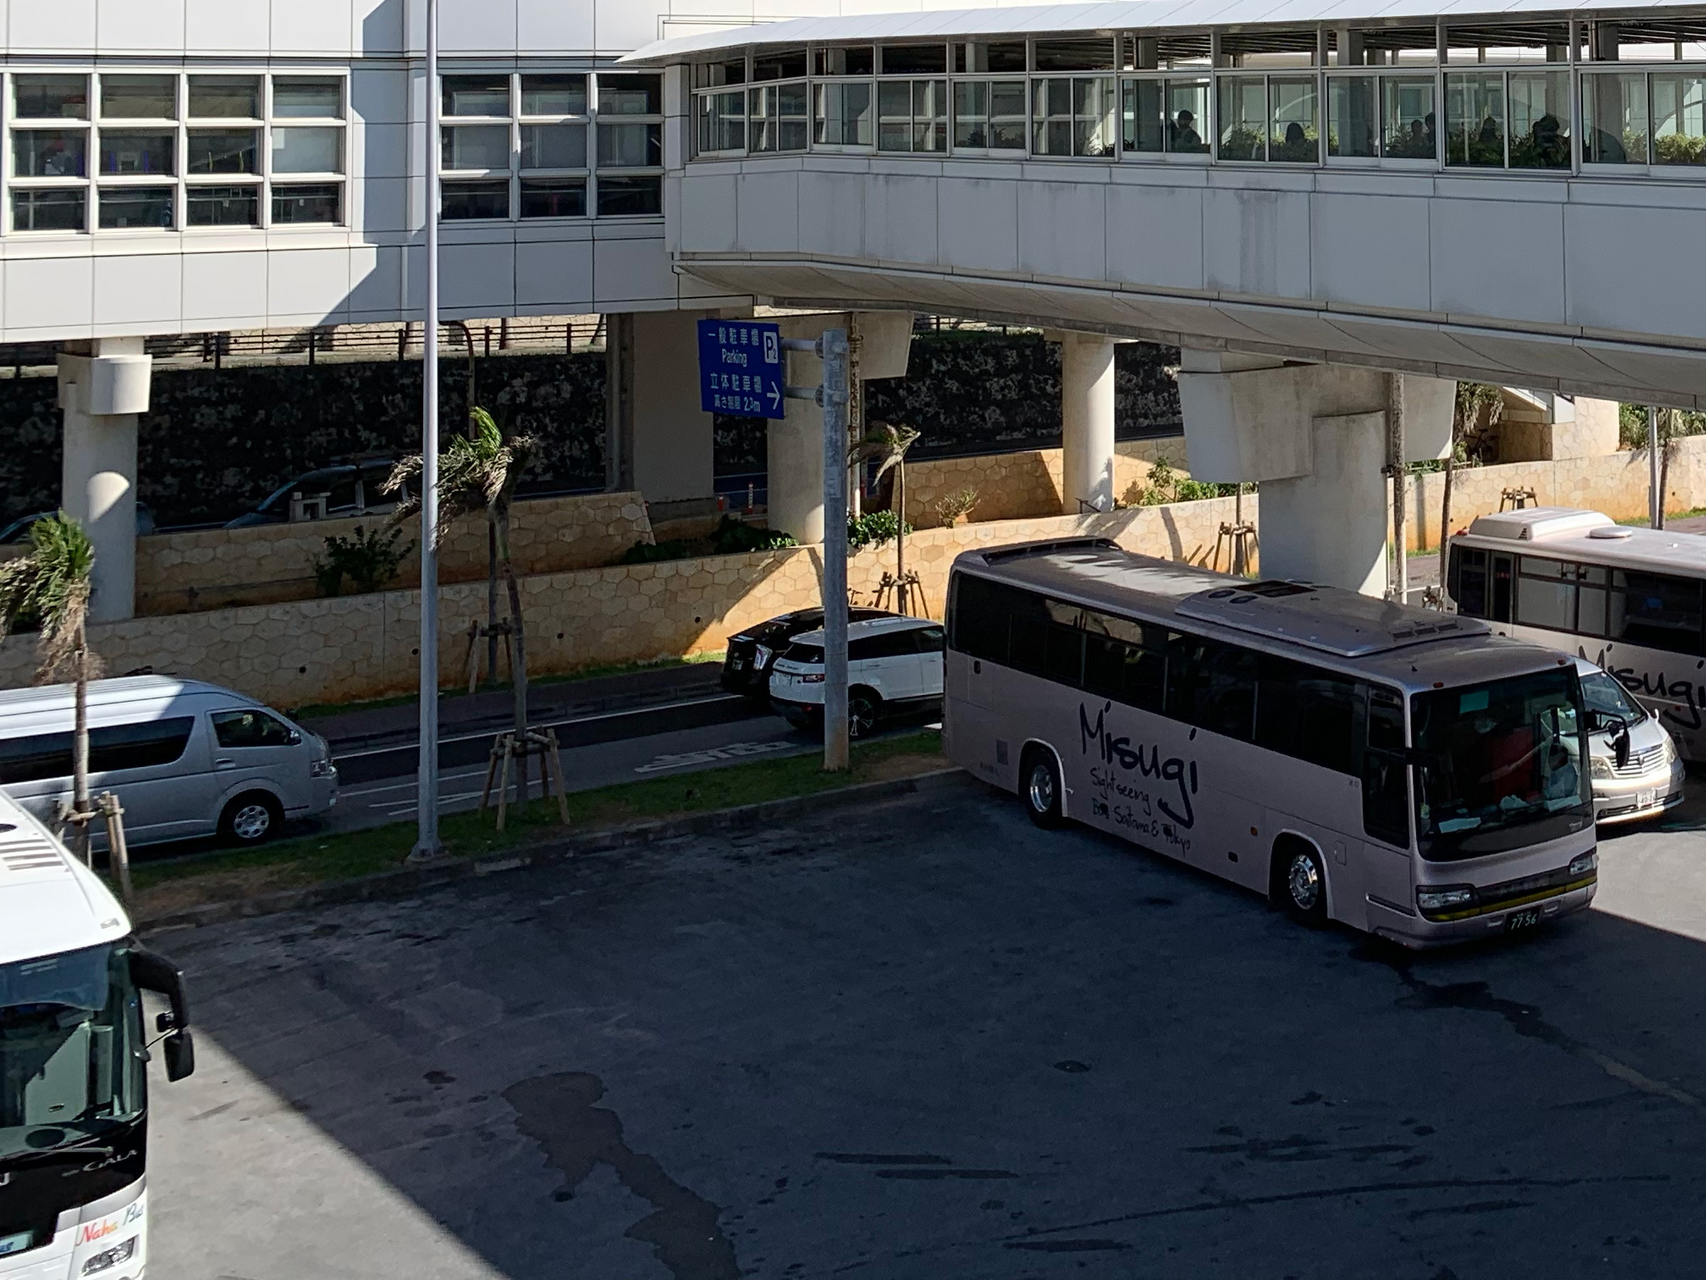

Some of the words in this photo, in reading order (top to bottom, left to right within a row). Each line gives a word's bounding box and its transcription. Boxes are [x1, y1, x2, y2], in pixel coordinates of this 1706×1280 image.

[721, 348, 748, 368] Parking
[710, 372, 763, 394] 立体駐車場
[1079, 701, 1198, 829] Misugi
[75, 1219, 119, 1247] Naha
